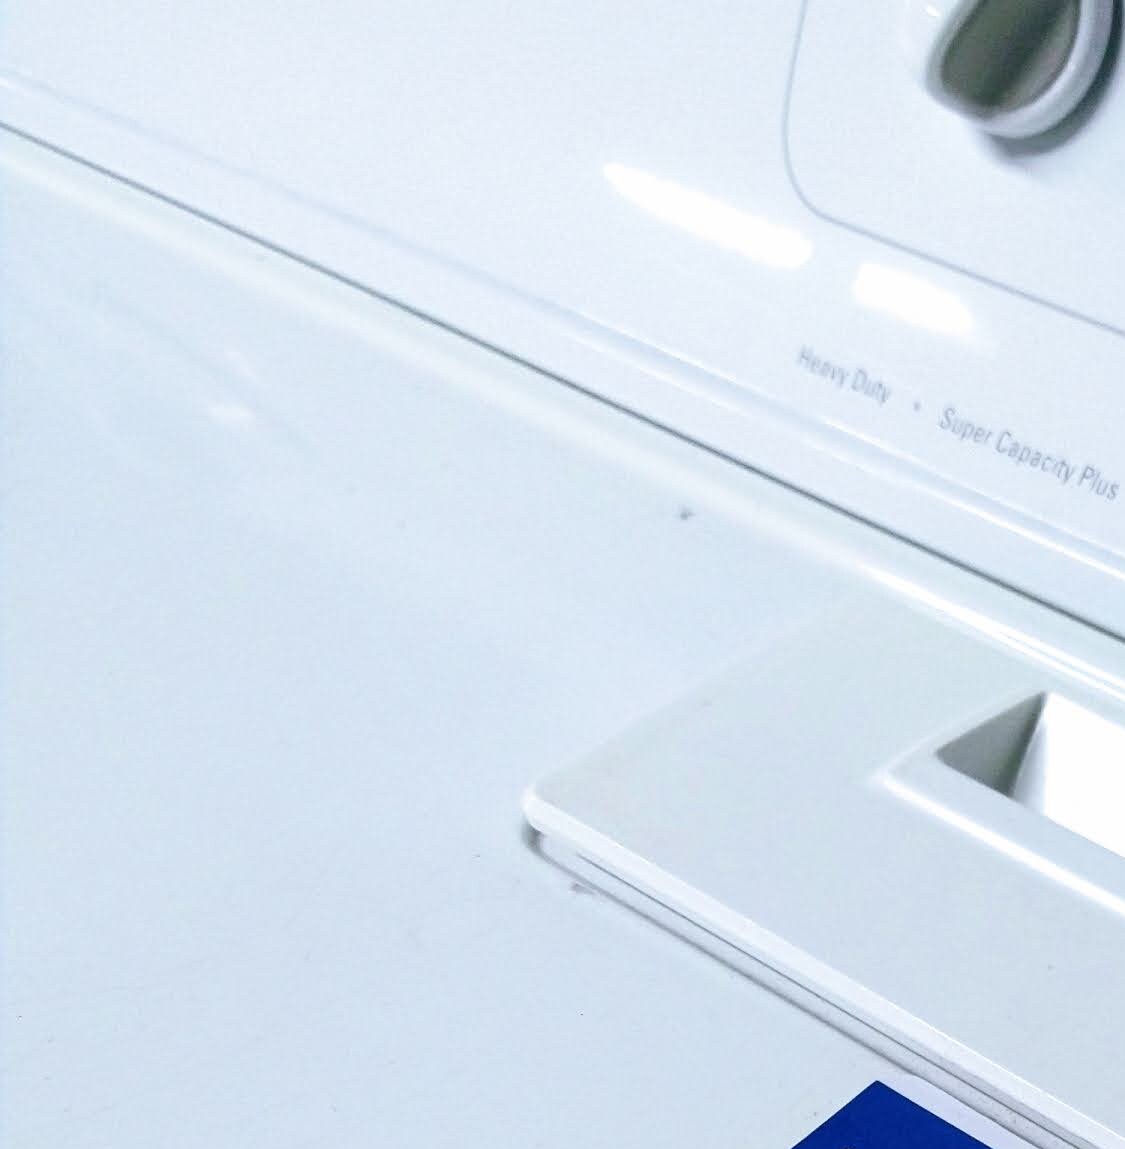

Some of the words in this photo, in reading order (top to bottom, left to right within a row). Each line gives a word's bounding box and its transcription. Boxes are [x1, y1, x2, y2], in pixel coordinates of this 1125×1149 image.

[797, 346, 849, 388] Heavy
[851, 367, 892, 405] Duty
[937, 406, 993, 444] Super
[995, 430, 1076, 485] Capacity
[1077, 464, 1121, 501] Plus
